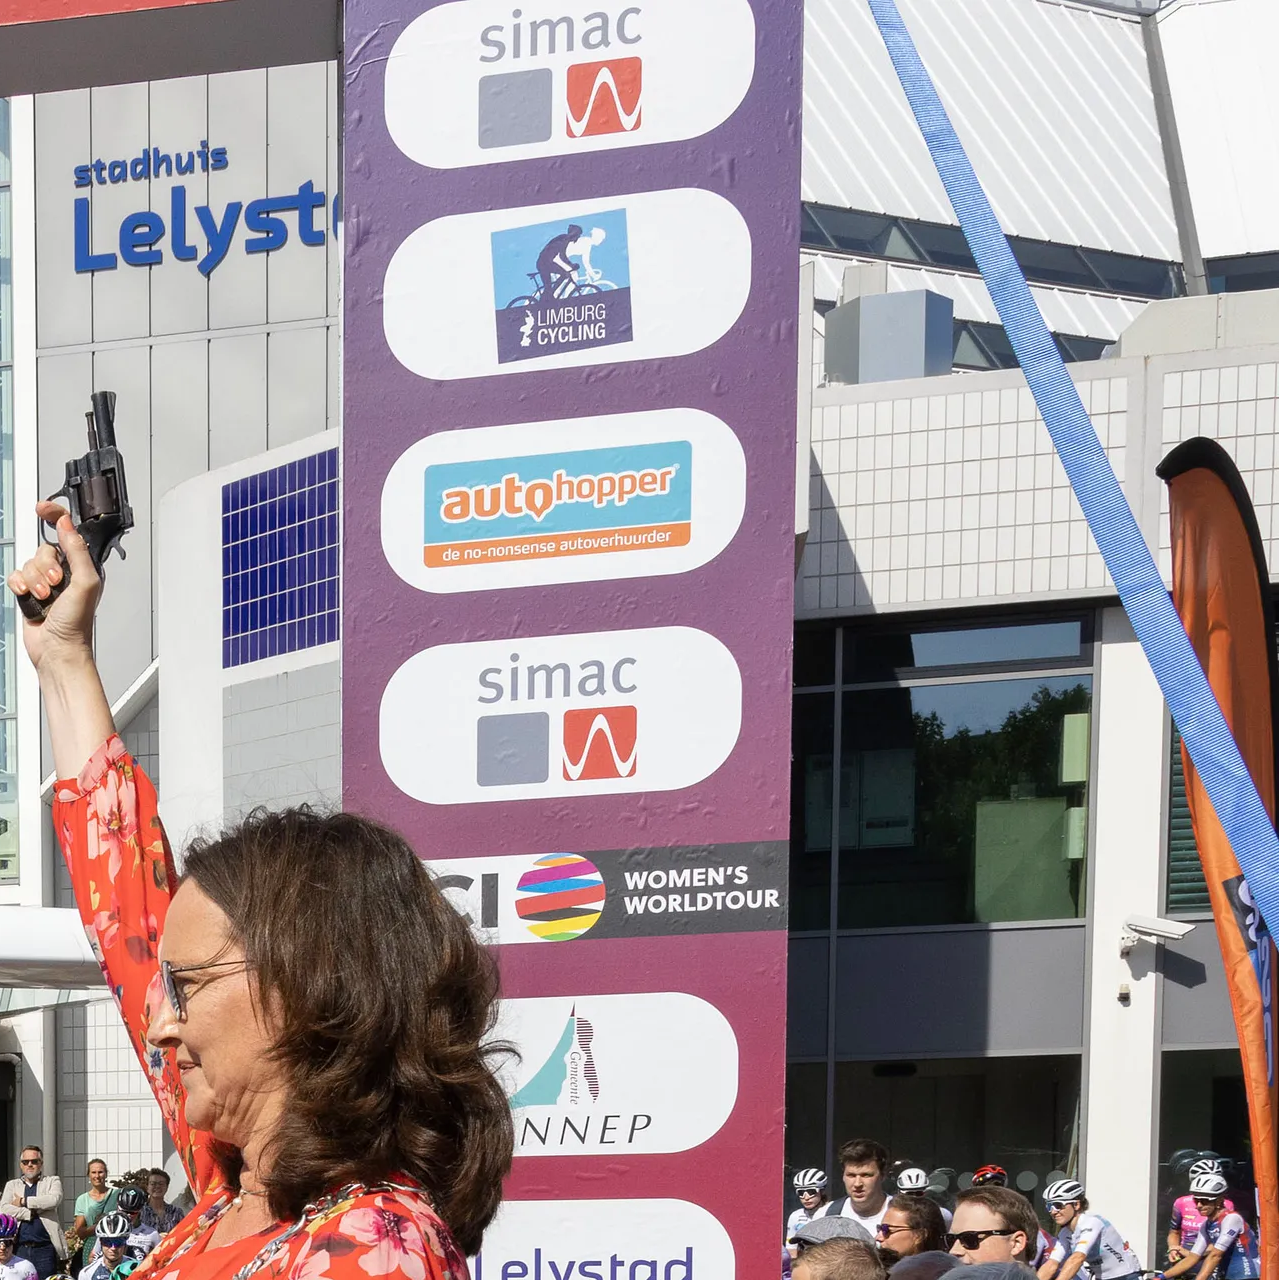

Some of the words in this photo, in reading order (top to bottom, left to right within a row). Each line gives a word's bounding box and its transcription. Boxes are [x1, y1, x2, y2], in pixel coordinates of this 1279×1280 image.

[479, 7, 643, 63] simac
[74, 140, 229, 187] stadhuis
[75, 180, 337, 276] Lelyst
[537, 303, 607, 327] LIMBURG
[537, 323, 607, 345] CYCLING
[442, 466, 673, 520] autohopper
[442, 546, 461, 562] de
[464, 540, 556, 560] no-nonsense
[560, 530, 672, 552] autoverhuurder
[477, 653, 638, 704] simac
[624, 866, 749, 891] WOMEN'S
[624, 889, 780, 915] WORLDTOUR
[570, 1051, 582, 1105] Gemeente
[521, 1115, 653, 1146] NNEP
[1103, 1242, 1125, 1263] TREK
